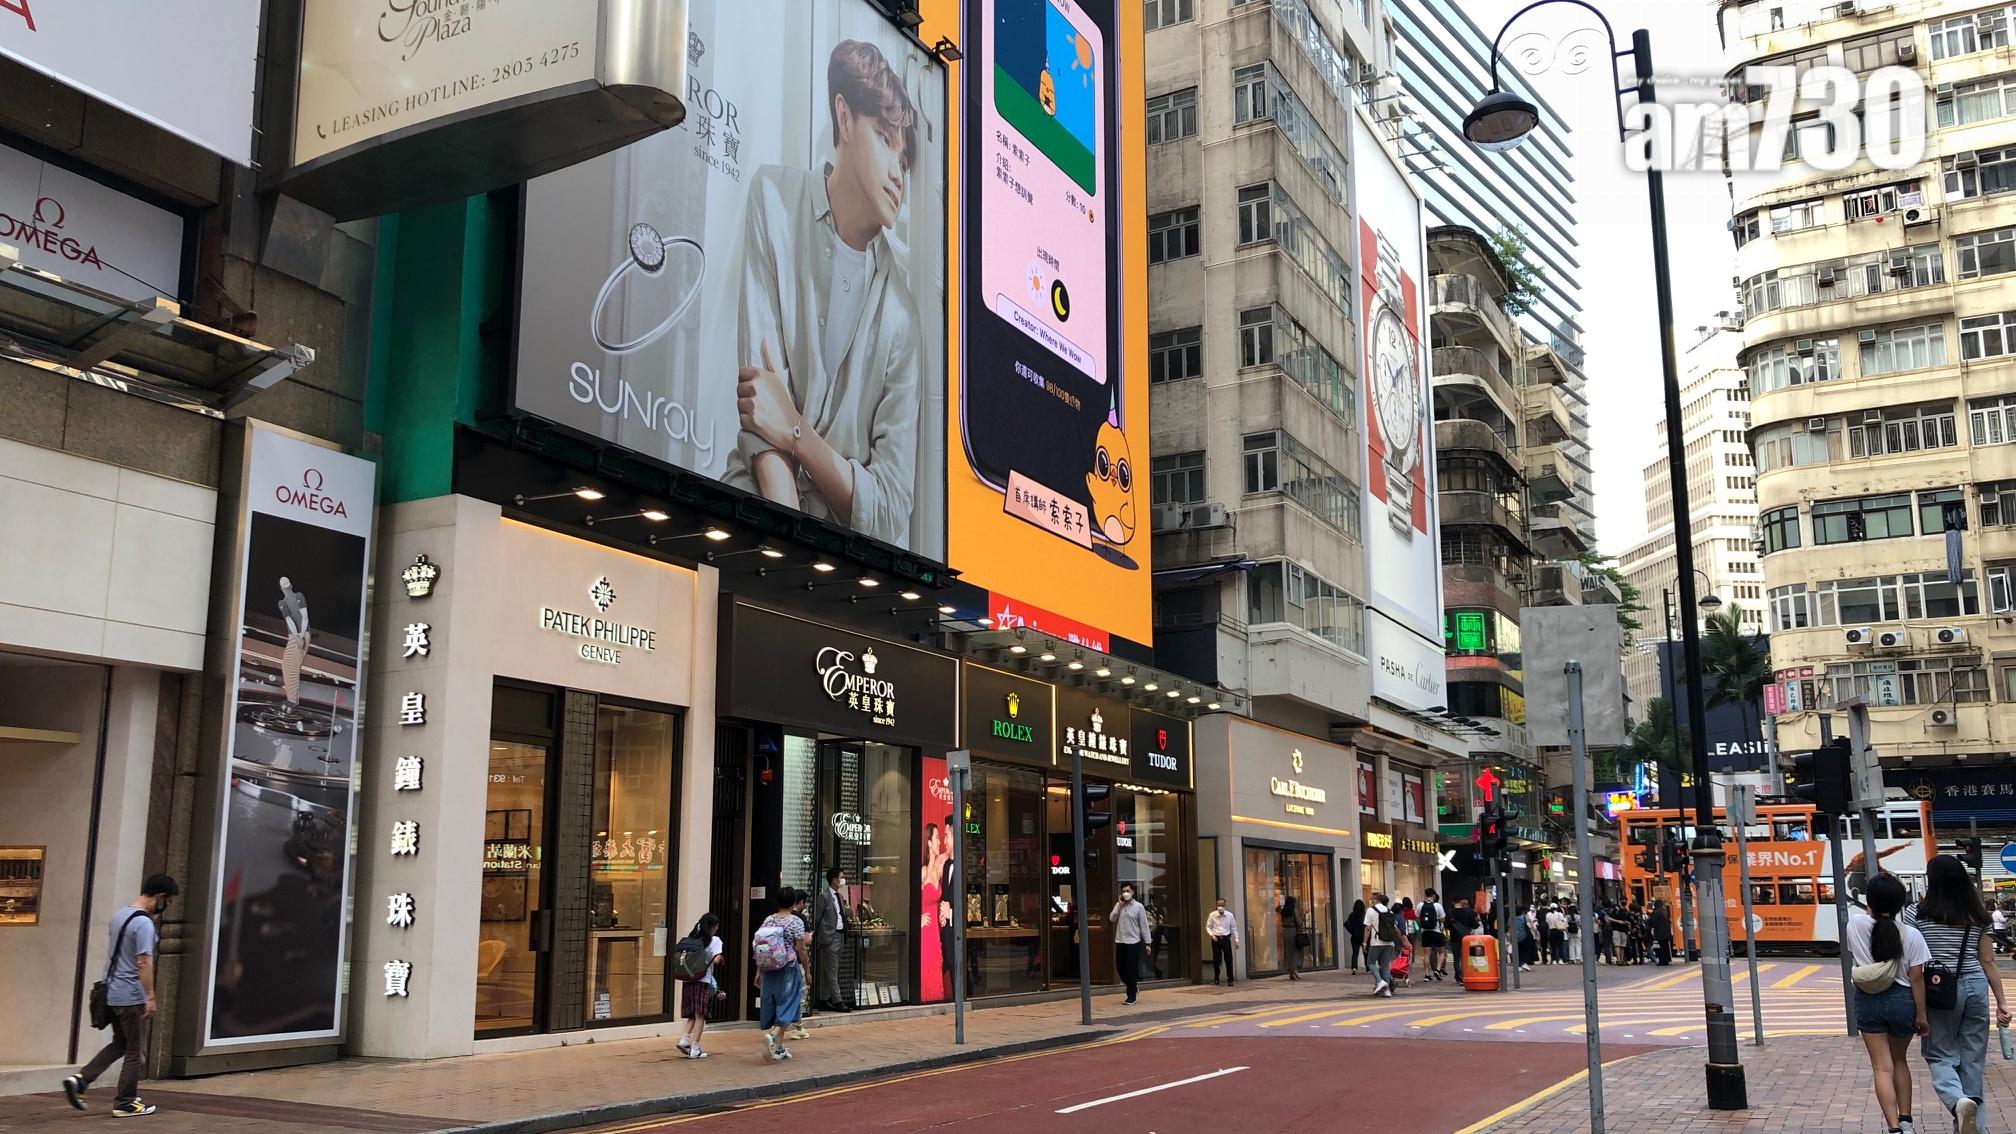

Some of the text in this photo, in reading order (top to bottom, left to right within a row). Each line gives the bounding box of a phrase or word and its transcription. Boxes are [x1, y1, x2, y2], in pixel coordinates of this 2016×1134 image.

[402, 16, 471, 61] Plaza
[332, 42, 579, 134] LEASING HOTLINE: 2803 4275
[694, 145, 740, 183] since 1942
[0, 212, 102, 271] OMEGA
[1013, 309, 1039, 336] Creator:
[1039, 327, 1058, 349] Where
[1058, 341, 1068, 356] We
[569, 361, 715, 469] SUNray
[275, 485, 348, 519] OMEGA
[1014, 485, 1085, 536] 首席講師 索索子
[541, 606, 656, 651] PATEK PHILIPPE
[579, 642, 622, 665] GENEVE
[816, 646, 895, 701] EMPEROR
[1380, 655, 1441, 696] PASHA DE Cartier
[848, 691, 895, 717] 英皇珠寶
[993, 719, 1033, 743] ROLEX
[1148, 752, 1178, 771] TUDOR
[383, 622, 430, 999] 英皇鐘錶珠寶
[1944, 783, 2014, 797] 香港賽馬
[966, 823, 981, 834] LEX
